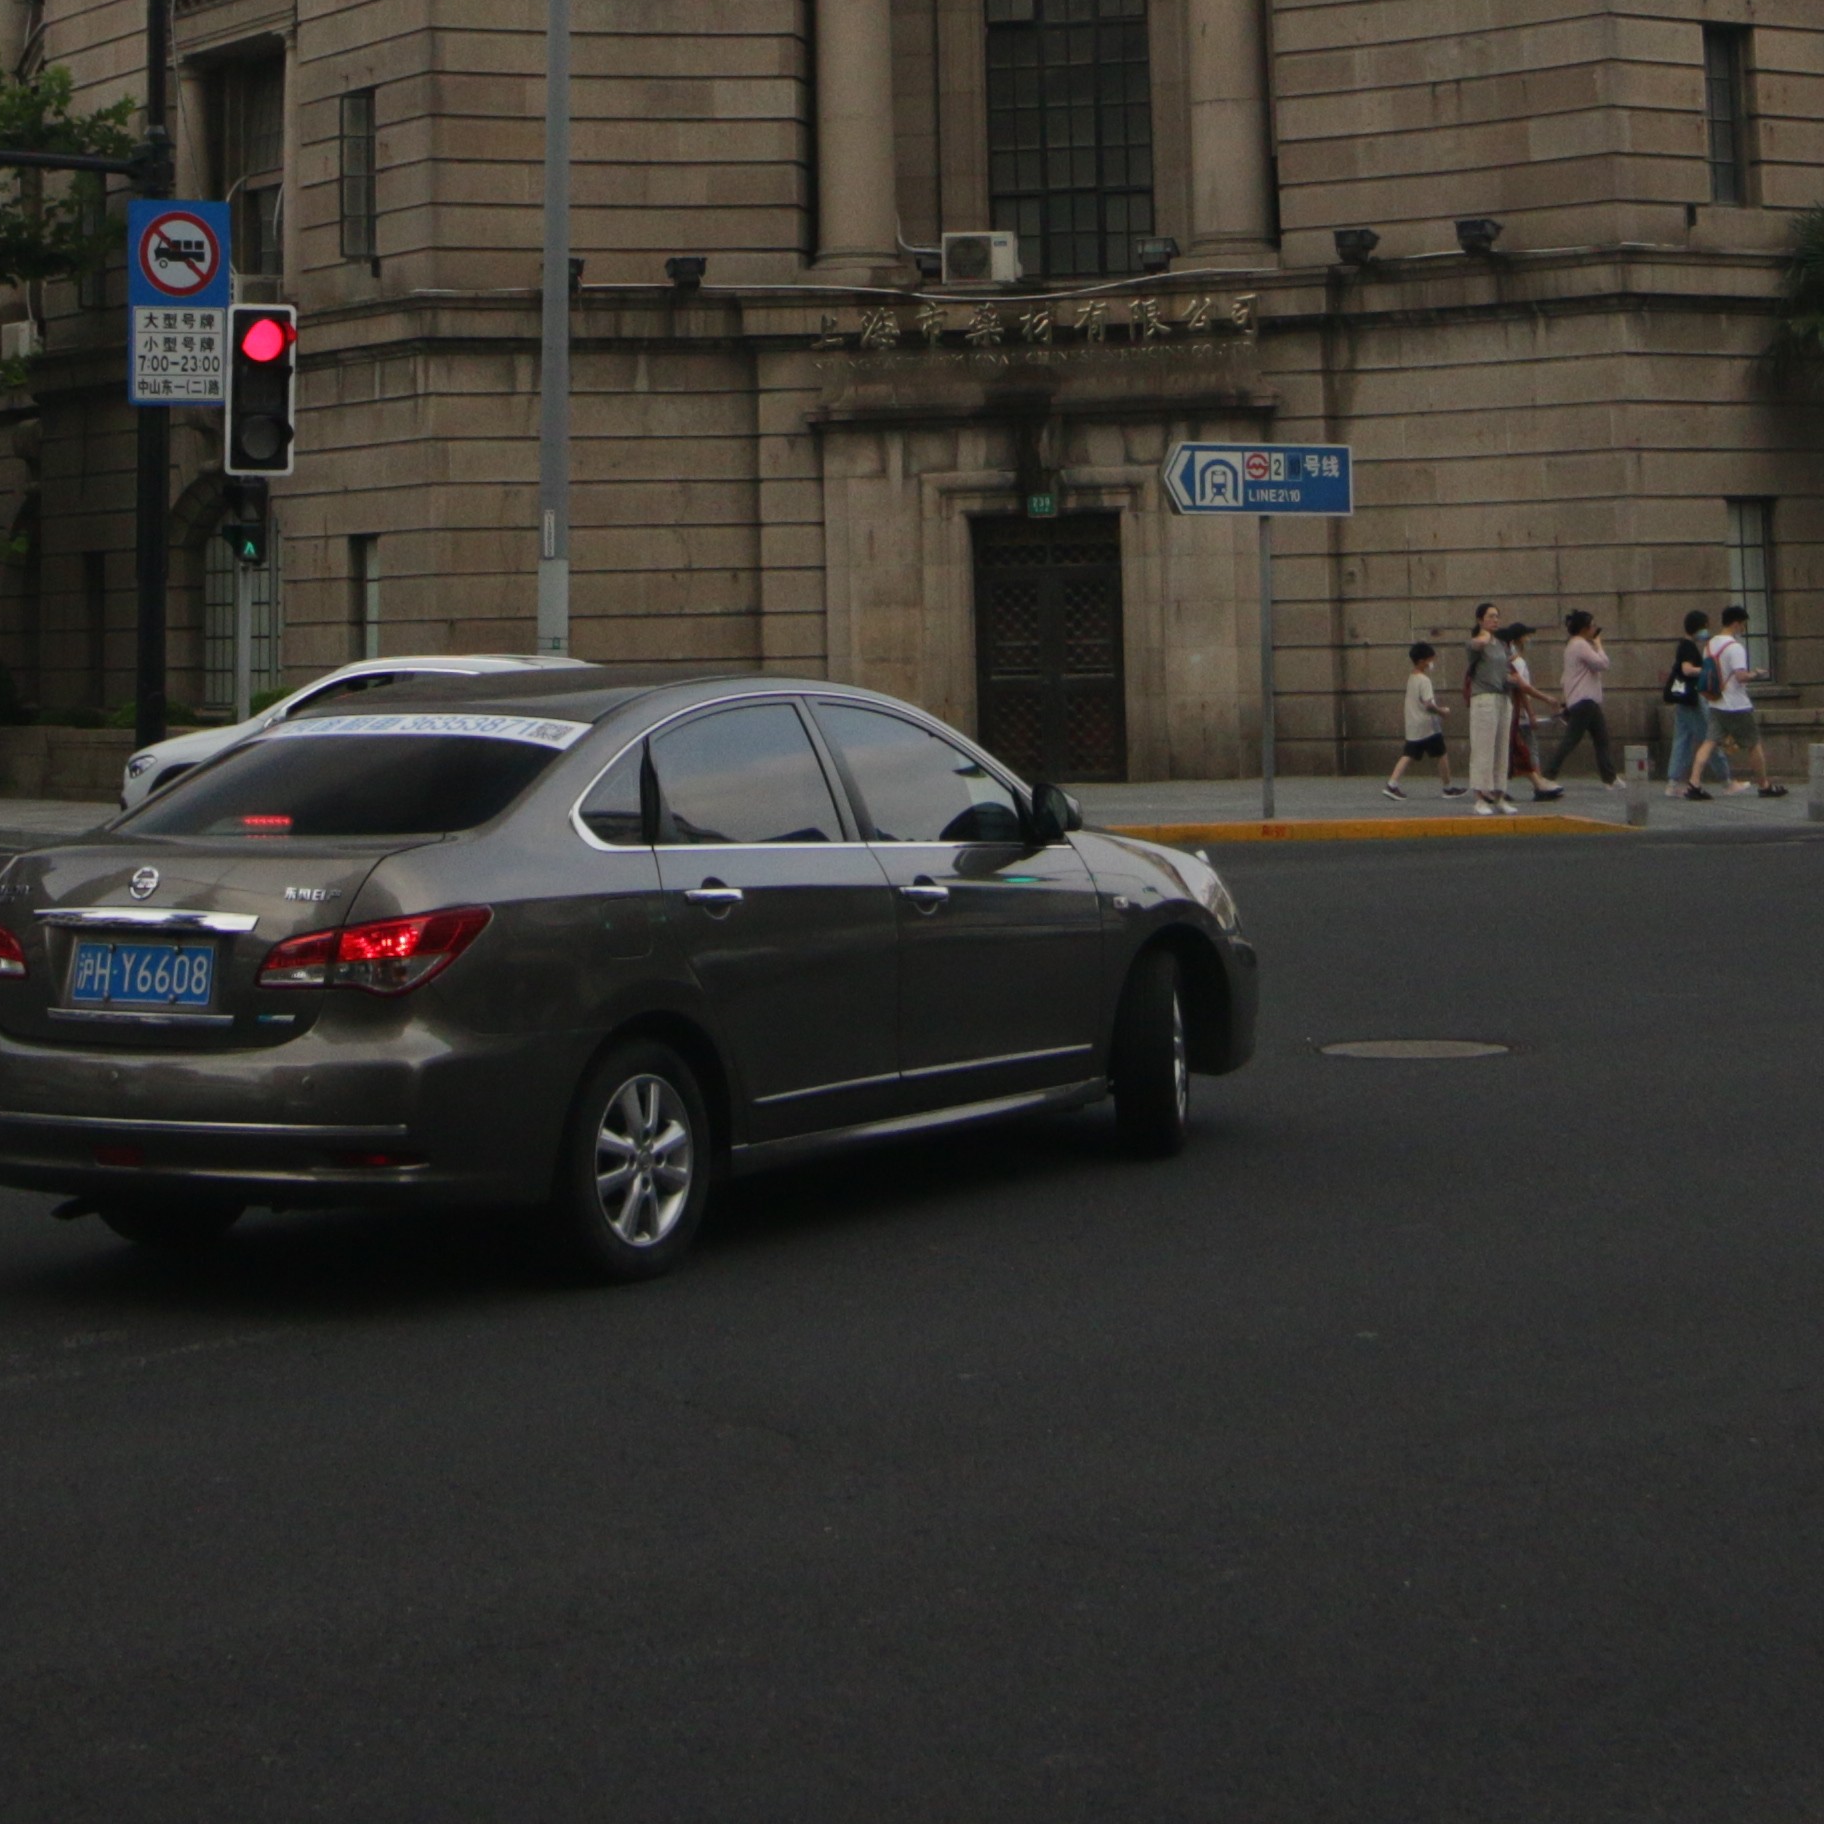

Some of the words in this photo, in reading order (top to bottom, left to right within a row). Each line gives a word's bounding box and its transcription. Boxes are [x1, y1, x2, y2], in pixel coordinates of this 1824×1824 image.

[144, 312, 215, 330] 大型号牌
[144, 336, 215, 353] 小型号牌
[137, 355, 220, 373] 7:00-23:00
[137, 378, 220, 396] 中山东一(二)路
[1273, 459, 1282, 476] 2
[1303, 455, 1340, 478] 号线
